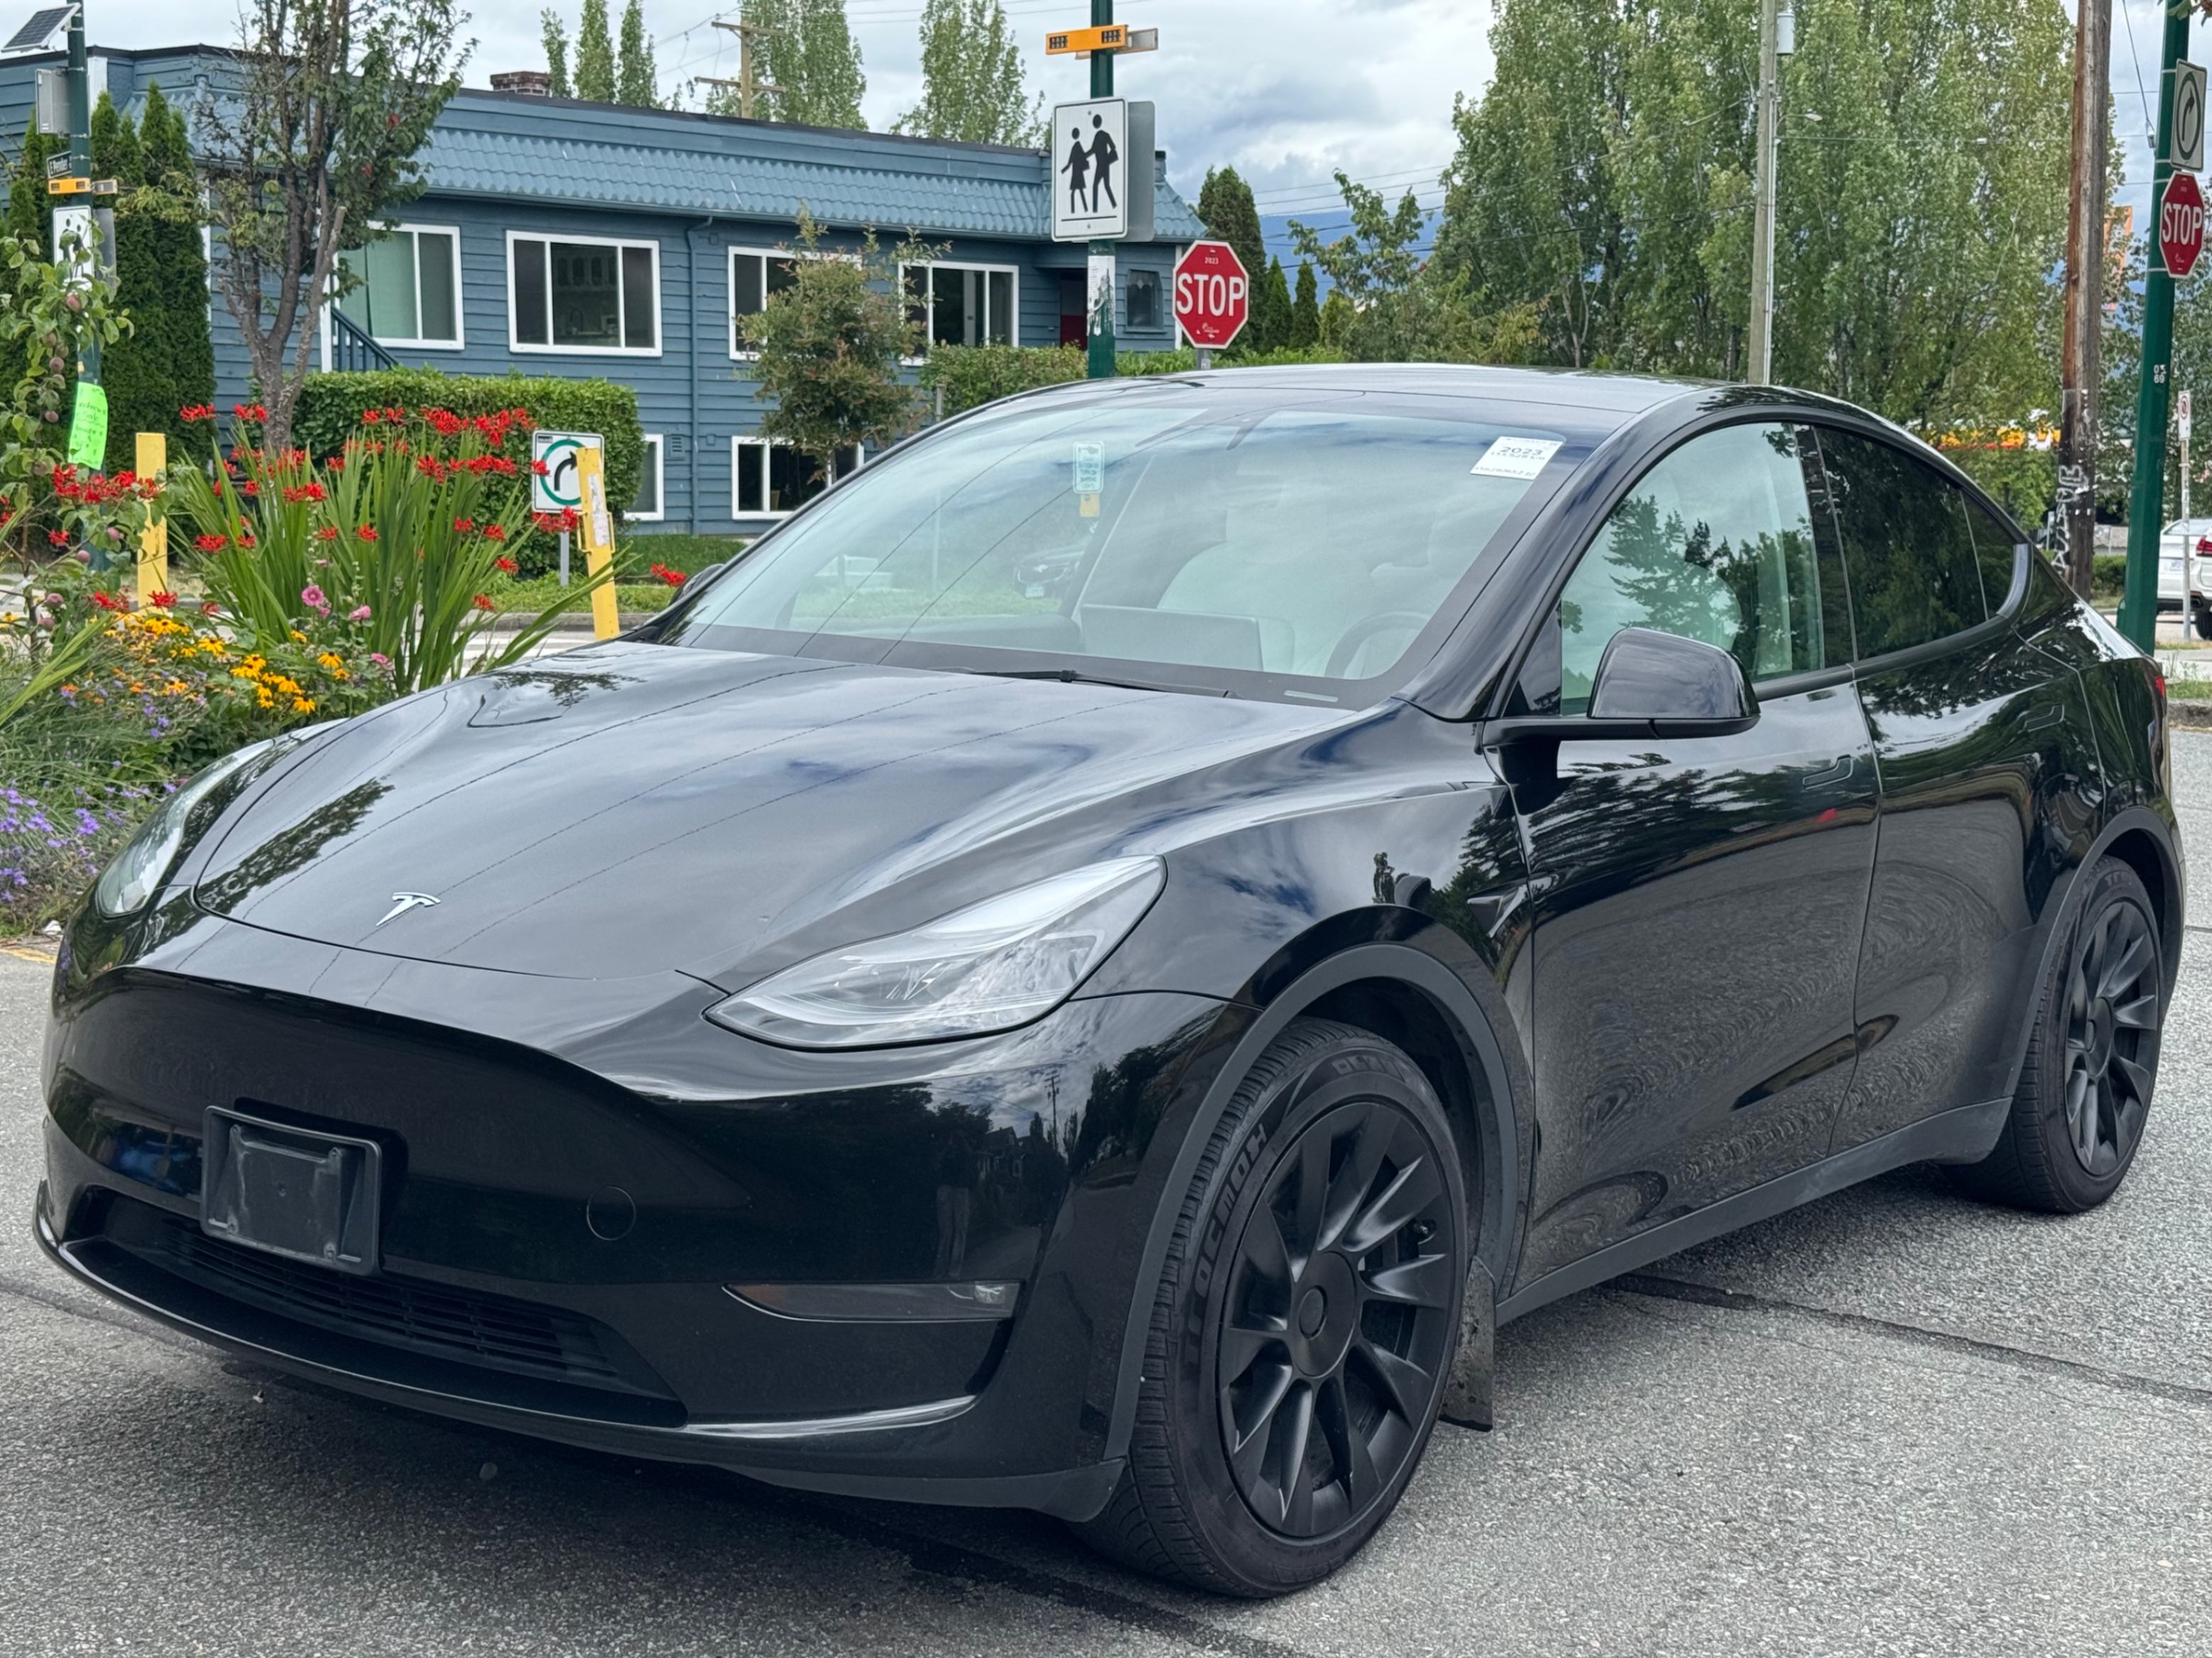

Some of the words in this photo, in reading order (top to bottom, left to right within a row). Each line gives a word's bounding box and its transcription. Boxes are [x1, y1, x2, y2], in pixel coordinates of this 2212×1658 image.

[2162, 201, 2203, 245] STOP
[1176, 272, 1245, 316] STOP
[2153, 374, 2164, 383] 69
[1500, 446, 1543, 456] 2023
